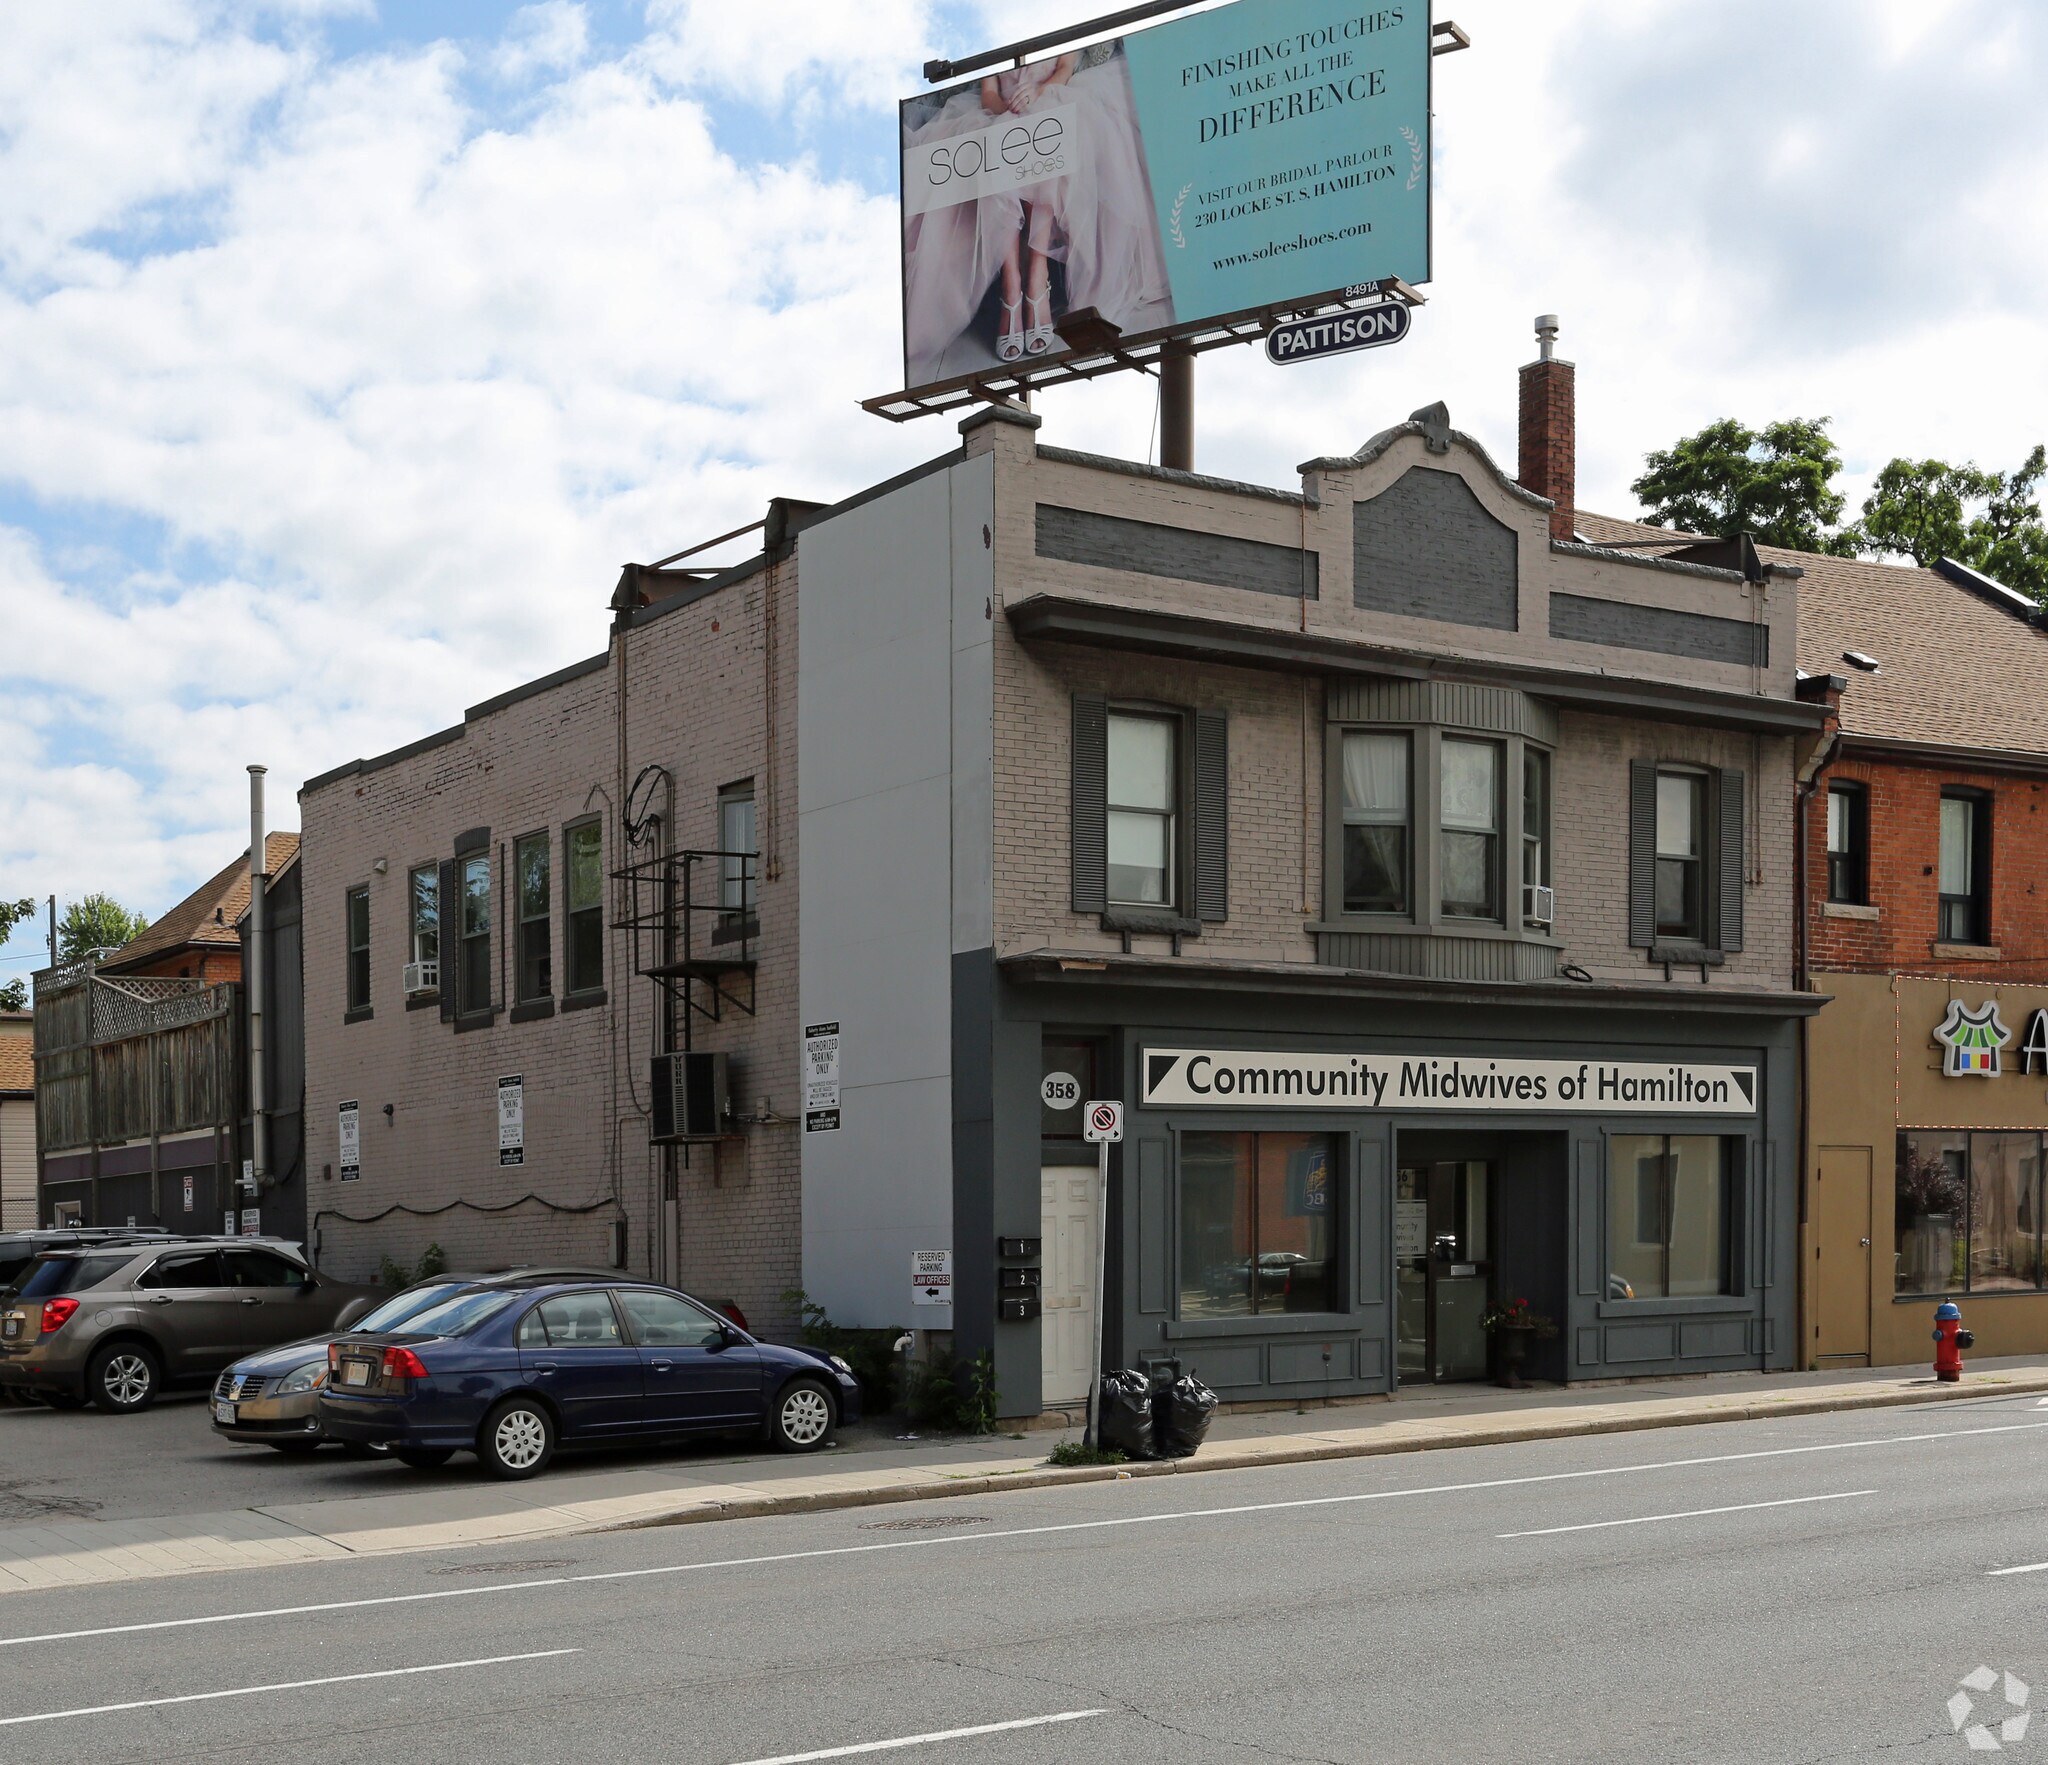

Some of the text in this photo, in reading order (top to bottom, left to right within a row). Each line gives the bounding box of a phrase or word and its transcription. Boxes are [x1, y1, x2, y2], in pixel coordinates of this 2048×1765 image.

[1181, 6, 1404, 87] FINISHING TOUCHES
[1229, 50, 1353, 99] MAKE ALL THE
[1198, 69, 1386, 144] DIFFERENCE
[1198, 144, 1392, 205] VISIT OUR BRIDAL PARLOUR
[1194, 211, 1217, 228] 230
[1221, 197, 1271, 221] LOCKE
[1275, 191, 1295, 206] ST.
[1314, 164, 1396, 197] HAMILTON
[1212, 222, 1372, 271] www.soleeshoes.com
[1345, 281, 1379, 297] 8491A
[1277, 310, 1397, 355] PATTISON
[807, 1038, 838, 1053] AUTHORIZED
[812, 1050, 834, 1063] PARKING
[816, 1062, 829, 1075] ONLY
[1186, 1055, 1728, 1106] Community Midwives of Hamilton
[1046, 1081, 1075, 1100] 358
[1020, 1243, 1024, 1253] 1
[917, 1252, 946, 1261] RESERVED
[920, 1263, 943, 1272] PARKING
[914, 1275, 950, 1285] LAW OFFICES
[1020, 1275, 1026, 1285] 2
[1019, 1305, 1025, 1316] 3
